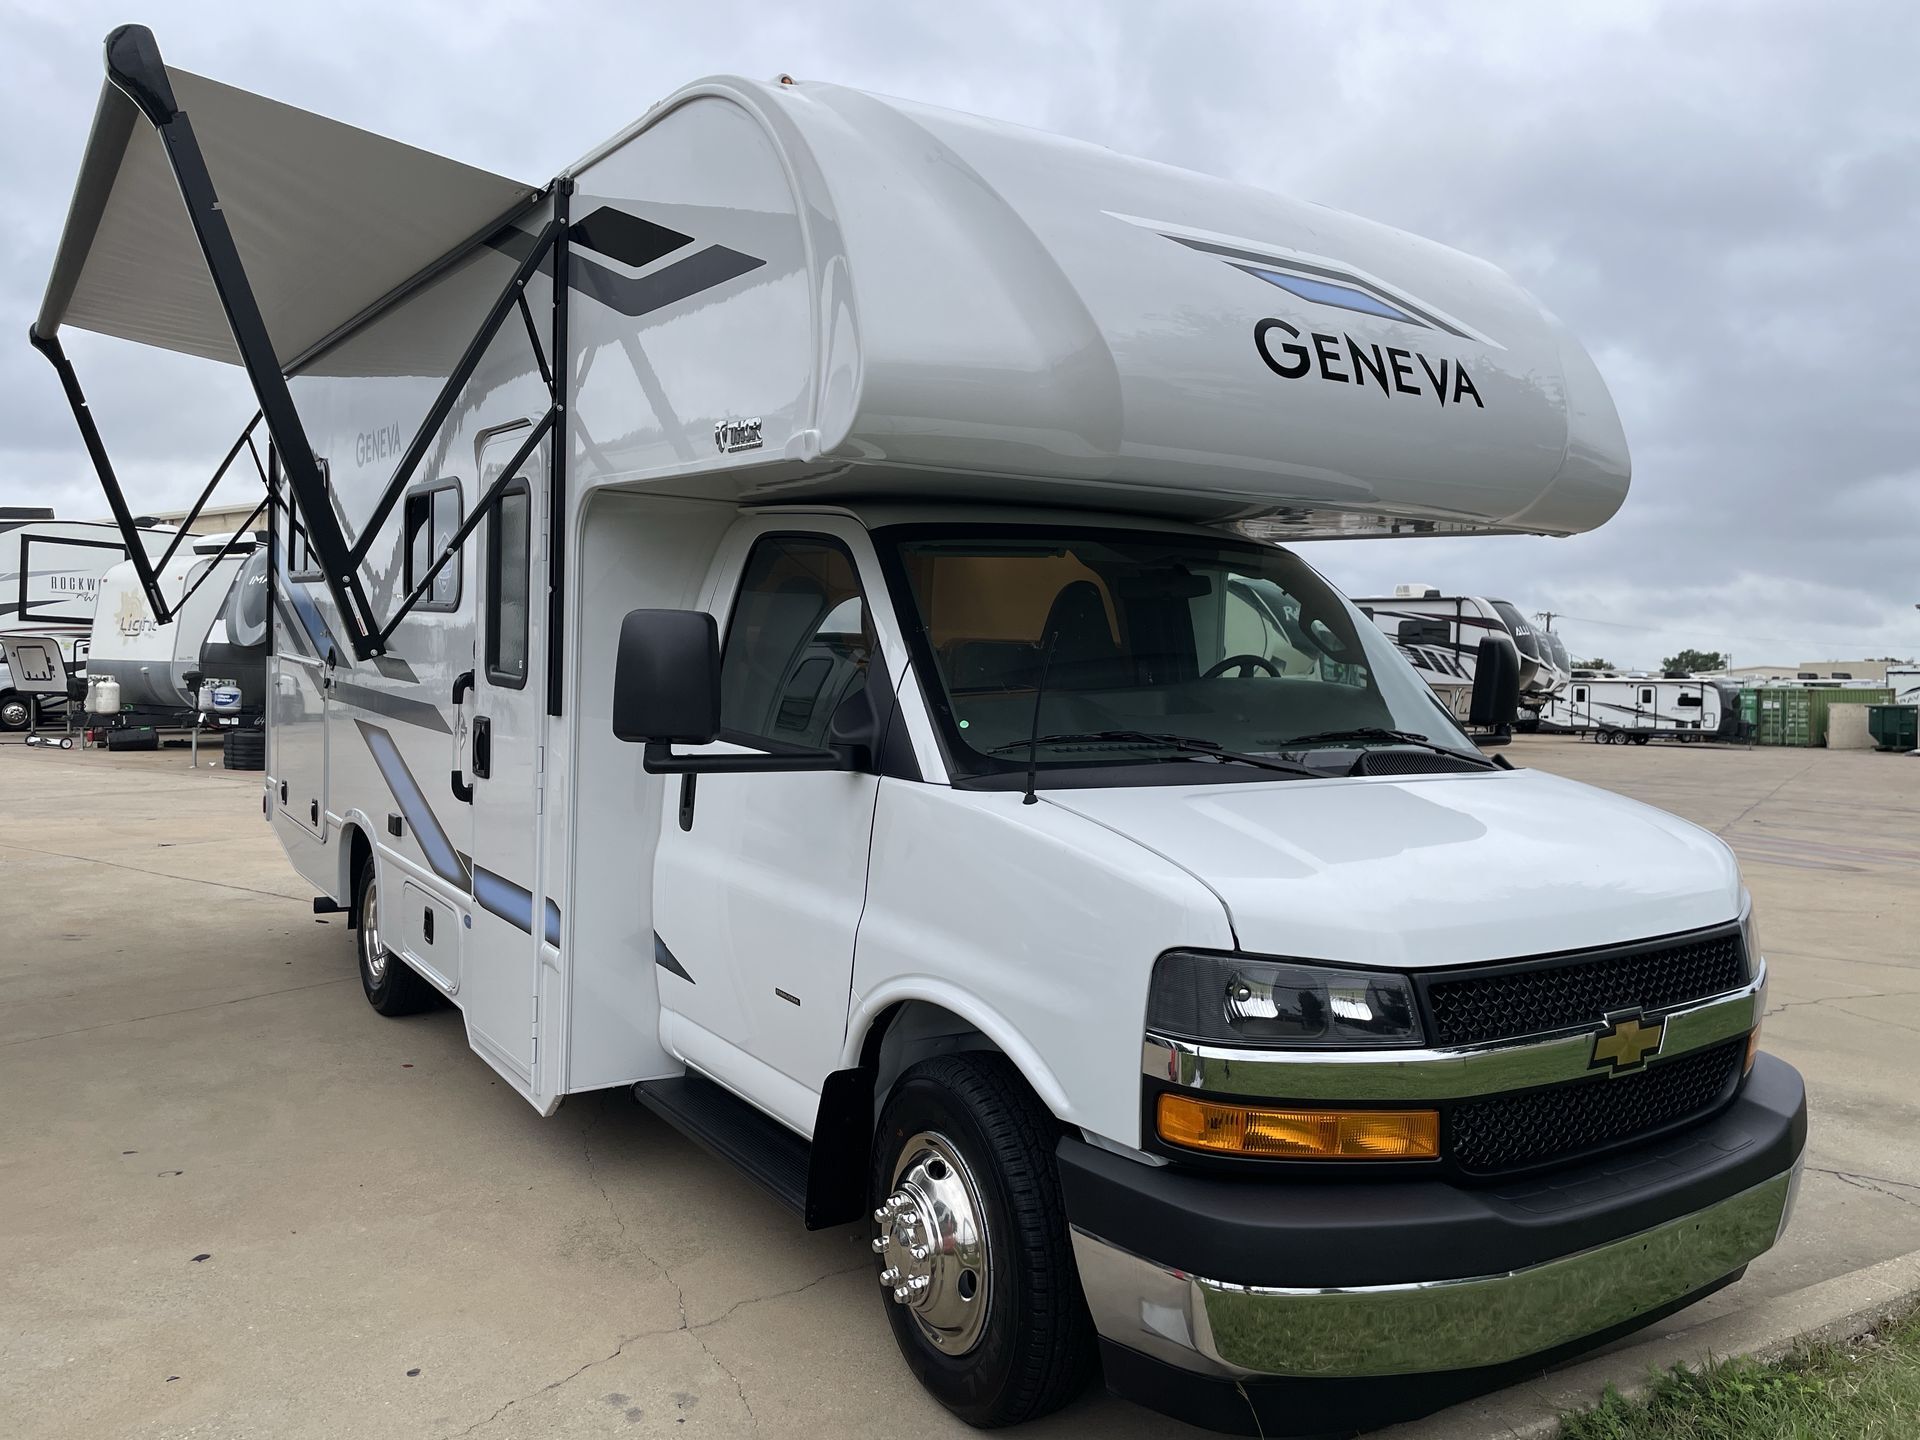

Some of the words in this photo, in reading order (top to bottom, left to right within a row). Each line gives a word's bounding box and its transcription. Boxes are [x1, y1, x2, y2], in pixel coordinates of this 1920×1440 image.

[1254, 318, 1485, 408] GENEVA
[356, 420, 401, 468] GENEVA
[51, 576, 101, 591] ROCKW
